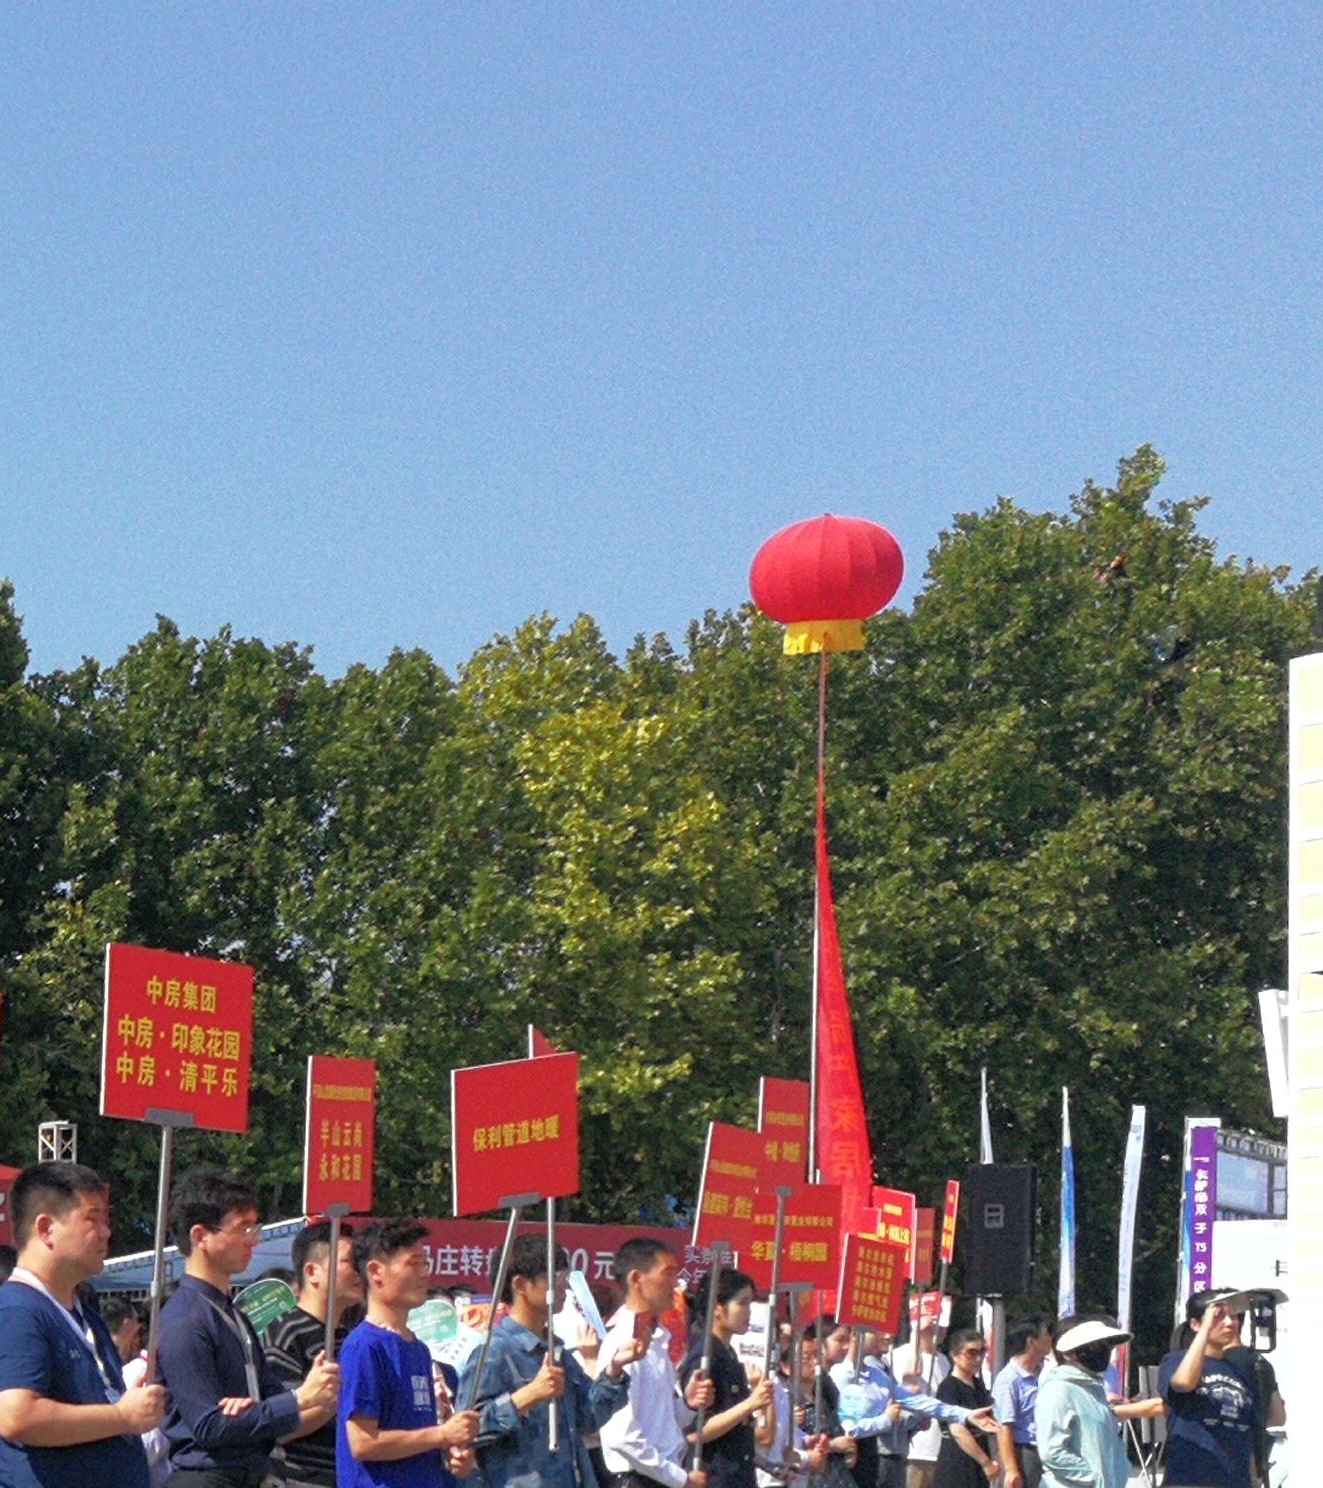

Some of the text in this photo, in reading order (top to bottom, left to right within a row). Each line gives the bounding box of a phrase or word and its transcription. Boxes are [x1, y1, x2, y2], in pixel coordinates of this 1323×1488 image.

[146, 975, 217, 1014] 中房集团
[117, 1013, 241, 1061] 中房·印象花园
[116, 1051, 238, 1097] 中房·清平乐
[473, 1114, 560, 1152] 保利管道地暖
